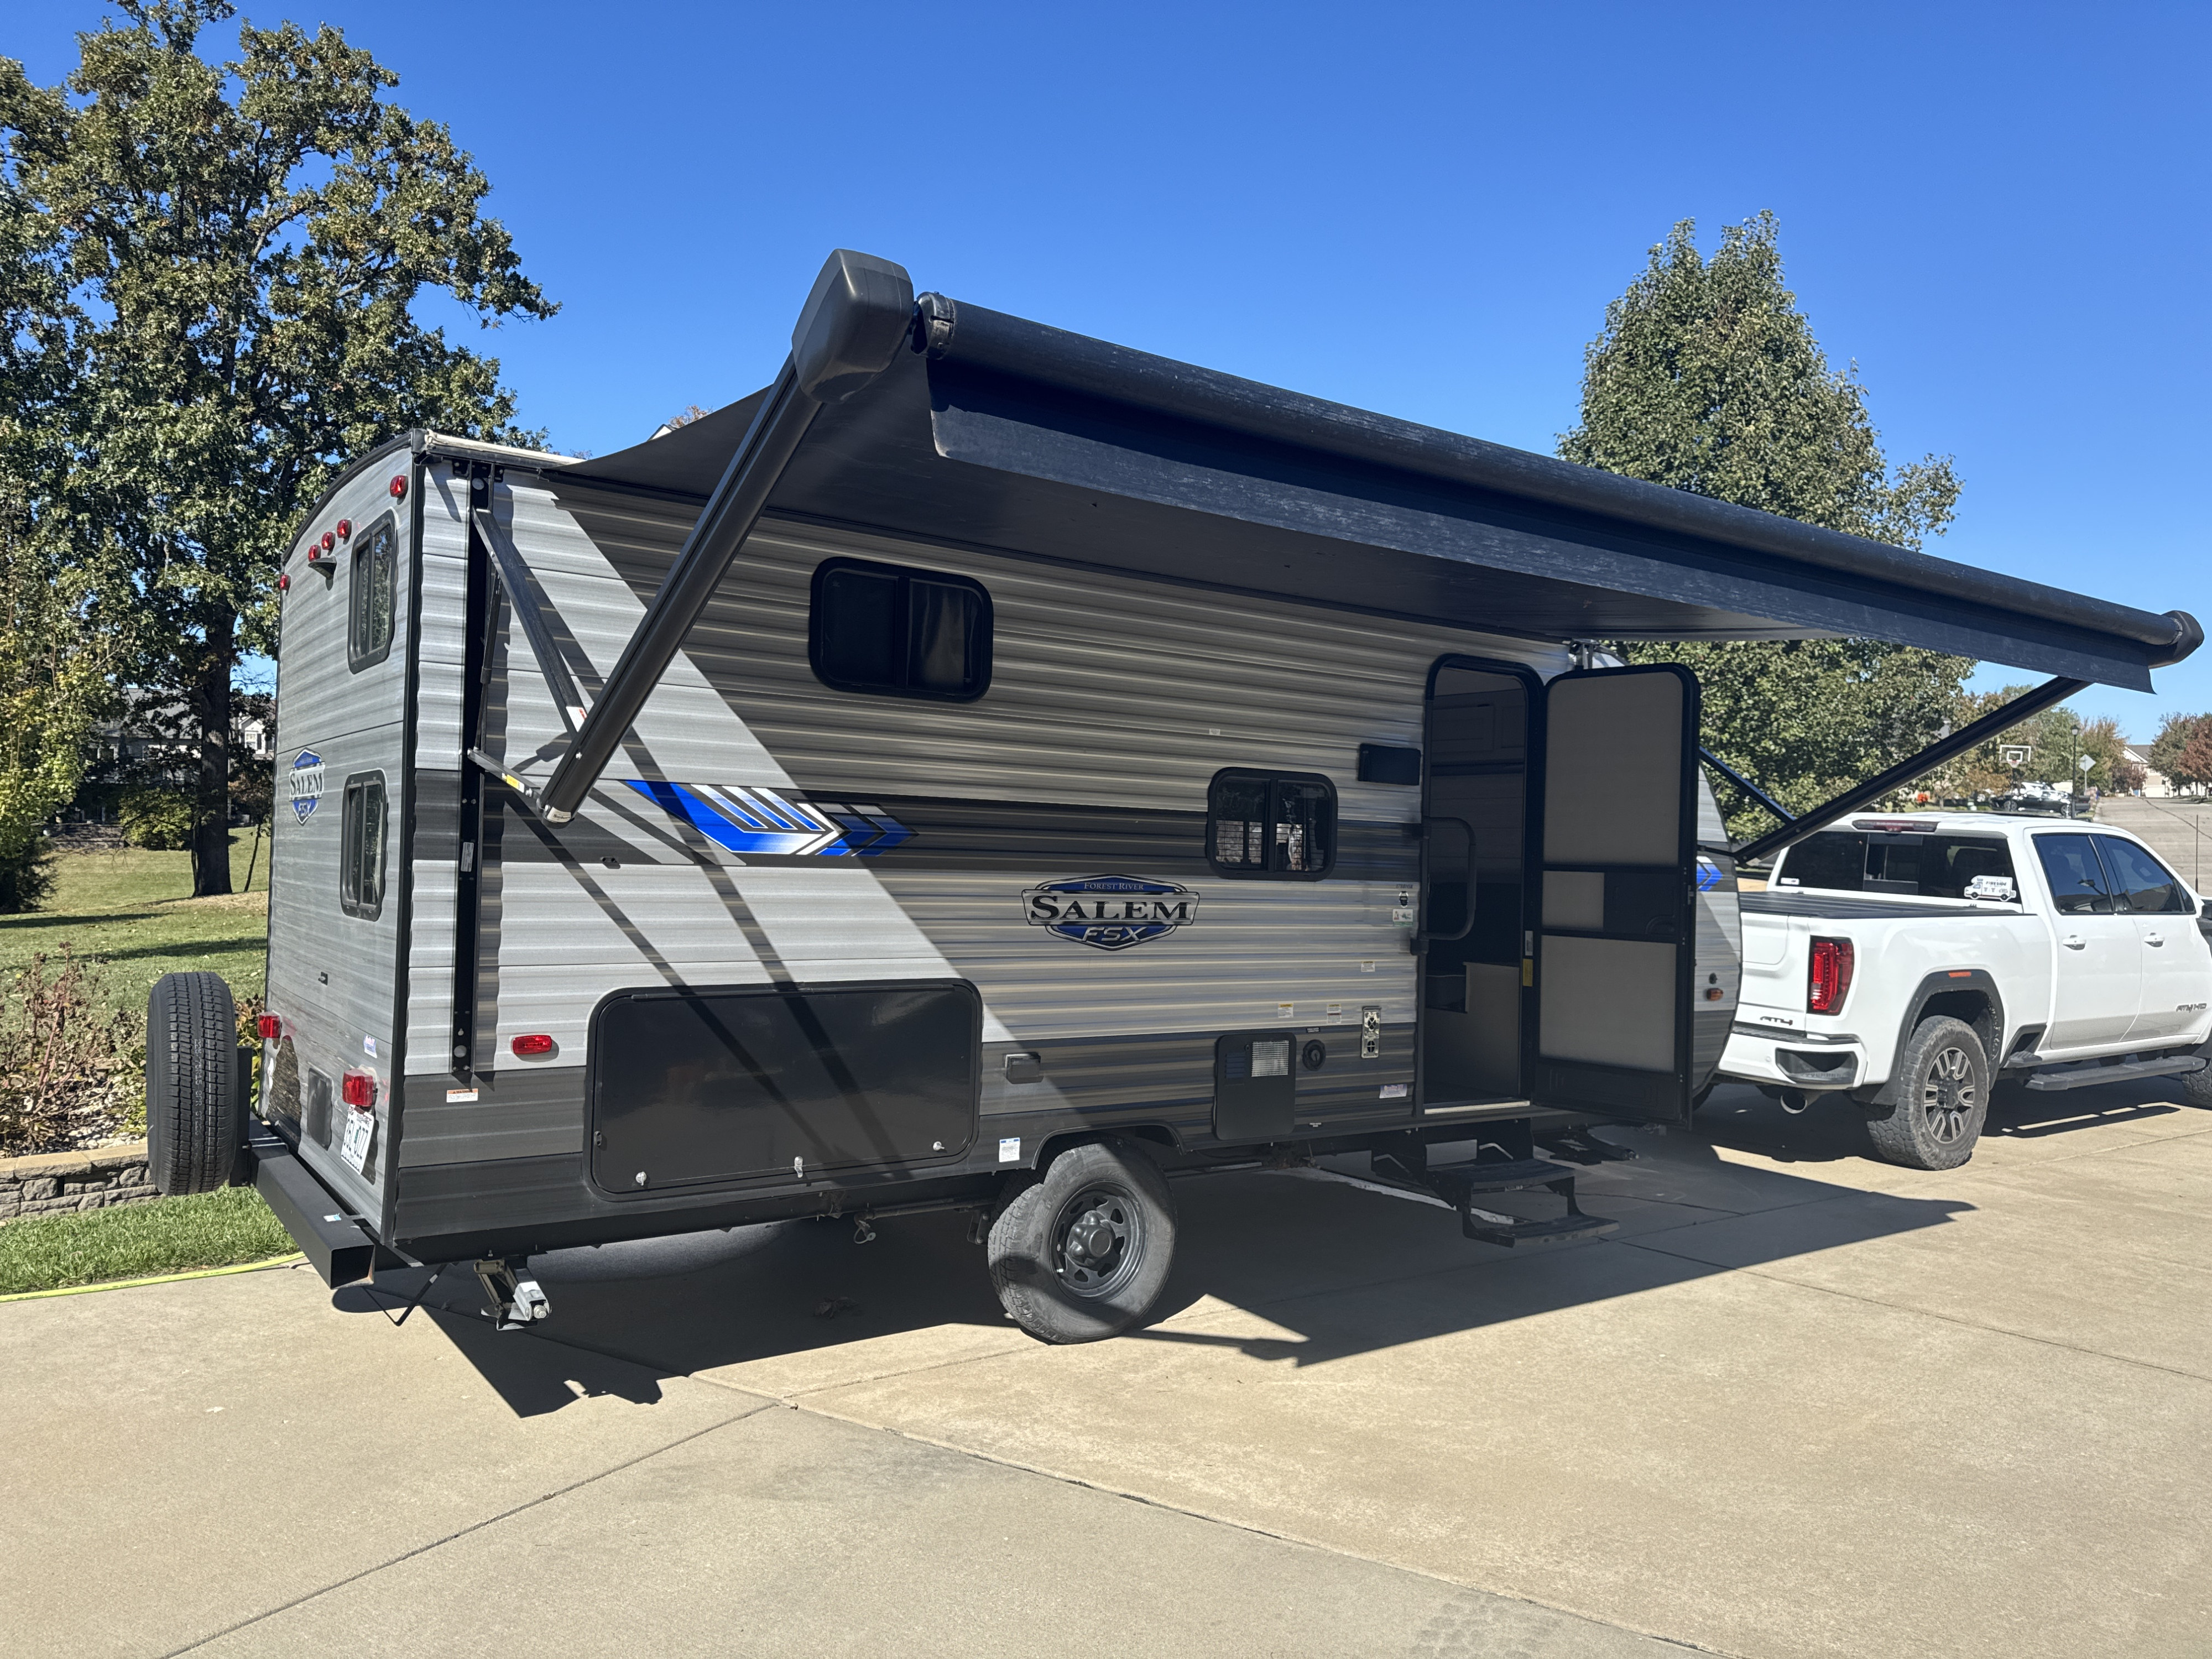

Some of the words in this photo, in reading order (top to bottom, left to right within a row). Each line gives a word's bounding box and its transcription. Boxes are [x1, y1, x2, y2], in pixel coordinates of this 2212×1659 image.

[290, 773, 322, 795] SALEM
[298, 801, 311, 817] FSX
[1031, 895, 1192, 920] SALEM
[1082, 926, 1147, 942] FSX
